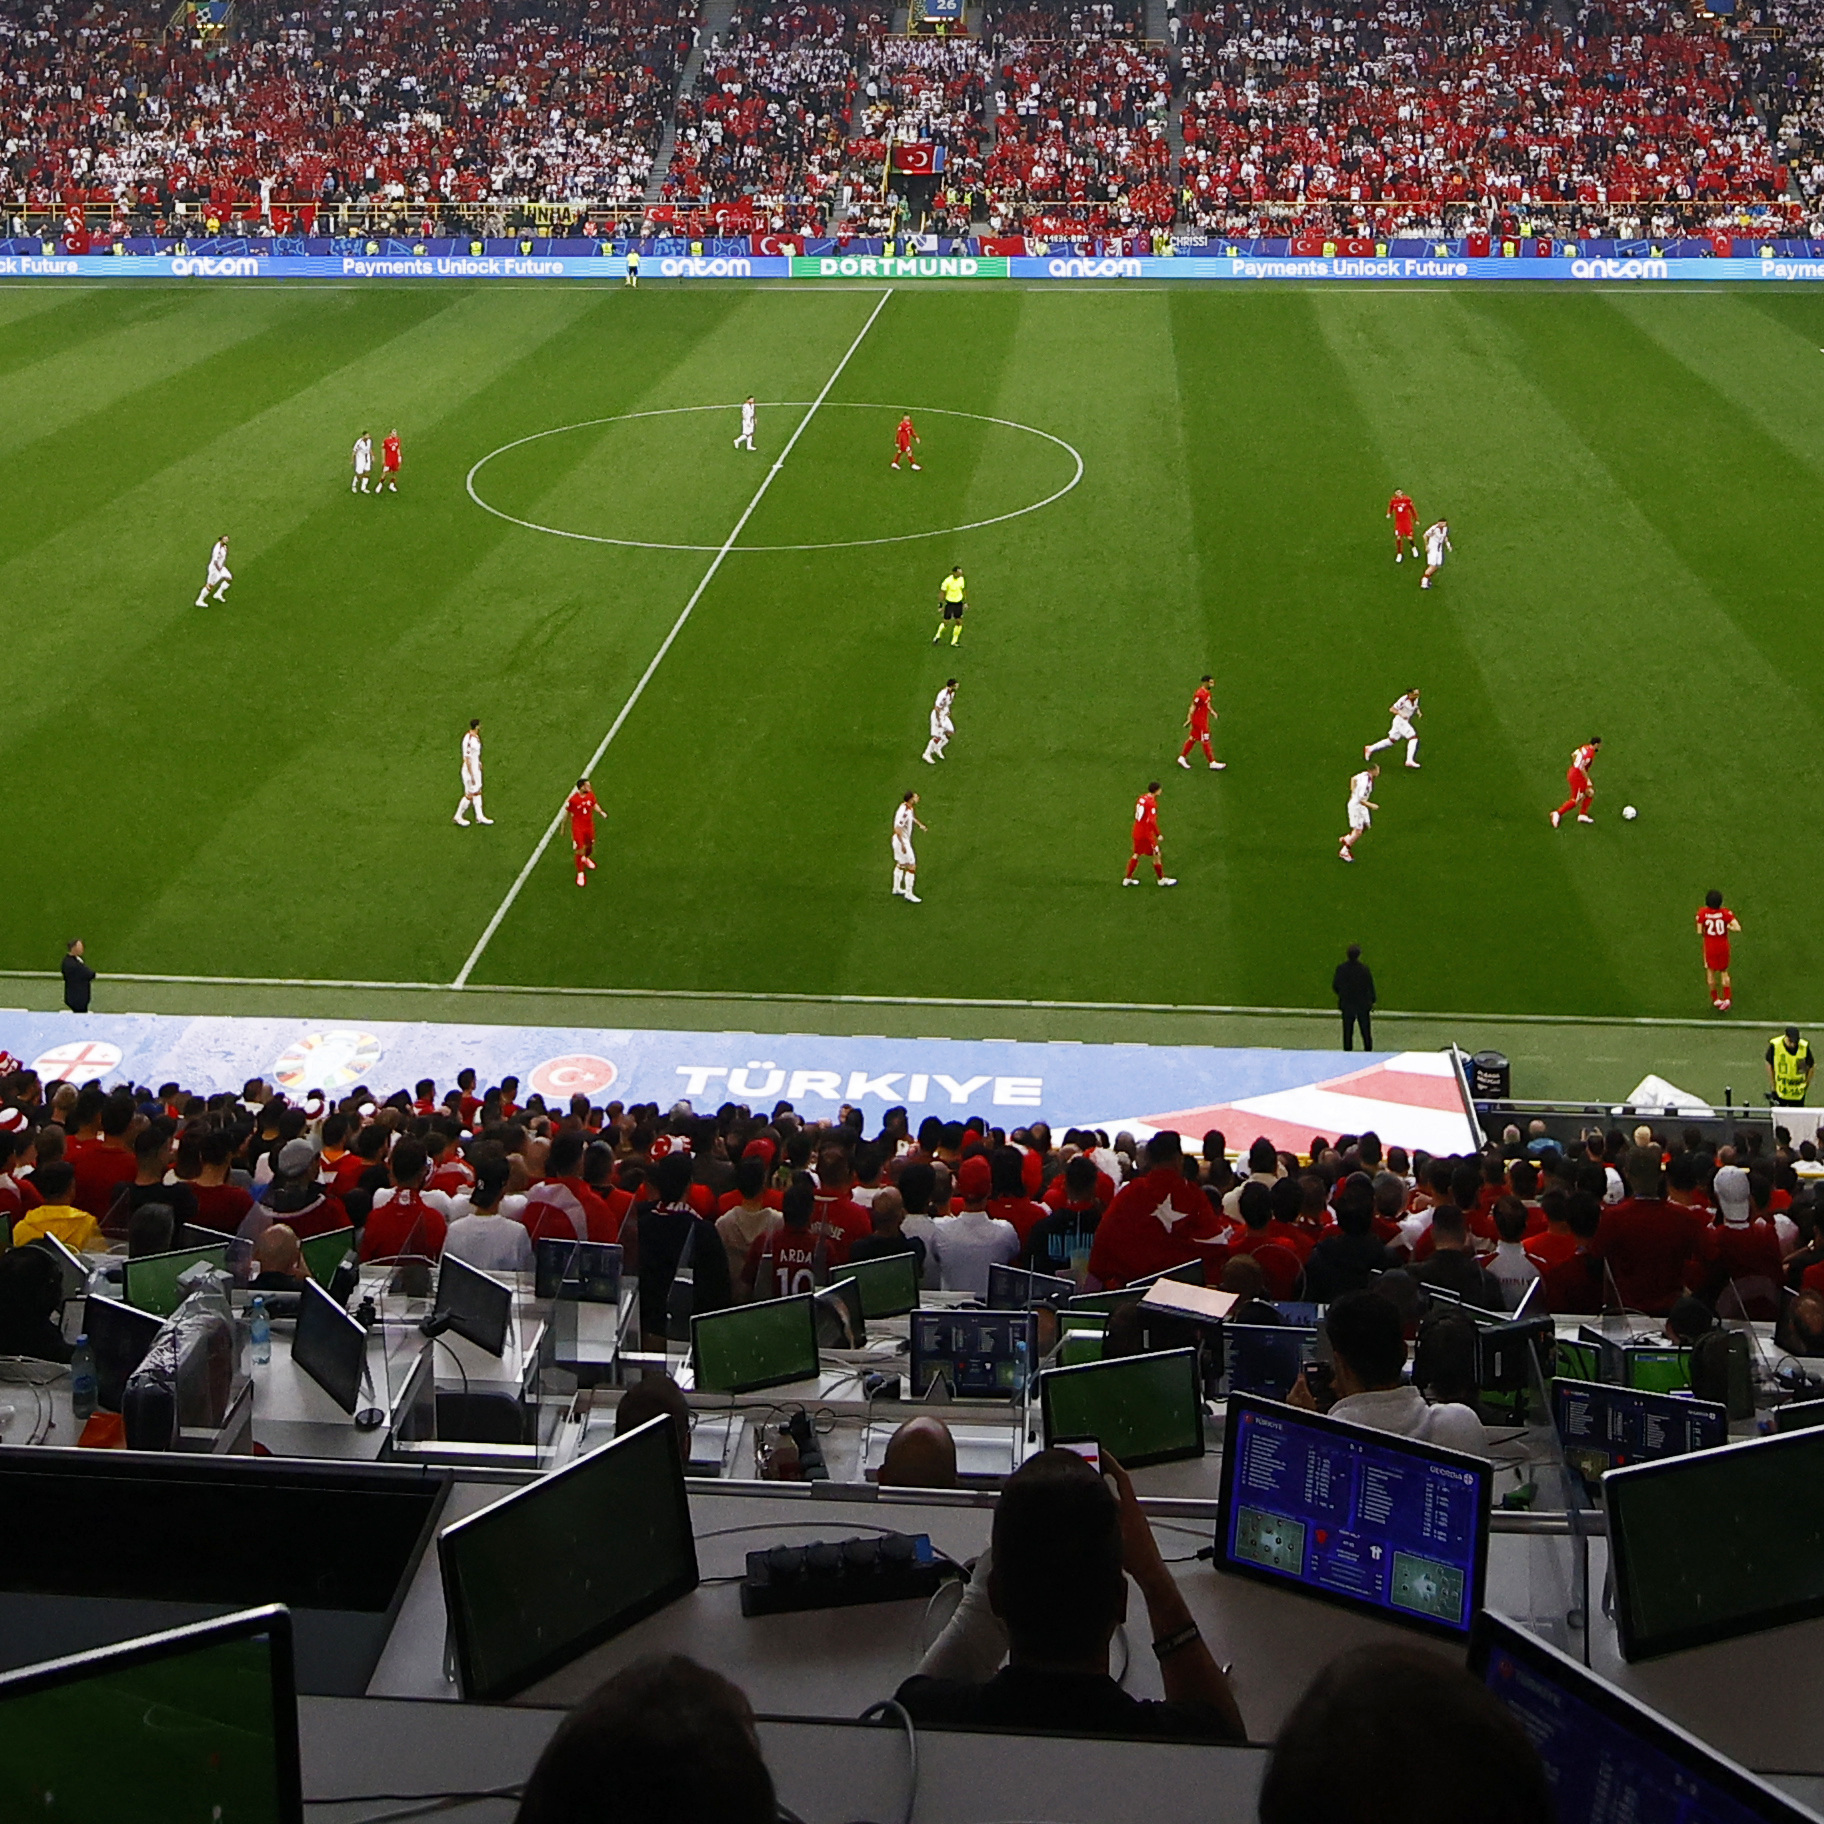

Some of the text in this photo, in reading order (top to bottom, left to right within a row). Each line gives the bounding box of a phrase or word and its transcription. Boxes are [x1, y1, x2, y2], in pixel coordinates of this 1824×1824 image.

[22, 257, 79, 274] Future
[171, 257, 259, 276] antom
[343, 258, 564, 276] Payments Unlock Future
[660, 258, 751, 277] antom
[820, 258, 978, 276] DORTMUND
[1048, 258, 1142, 277] antom
[1232, 259, 1468, 278] Payments Unlock Future
[1571, 259, 1668, 279] antom
[1704, 918, 1726, 936] 20
[676, 1061, 1043, 1106] TÜRKIYE
[779, 1248, 812, 1264] ARDA
[776, 1267, 814, 1296] 10
